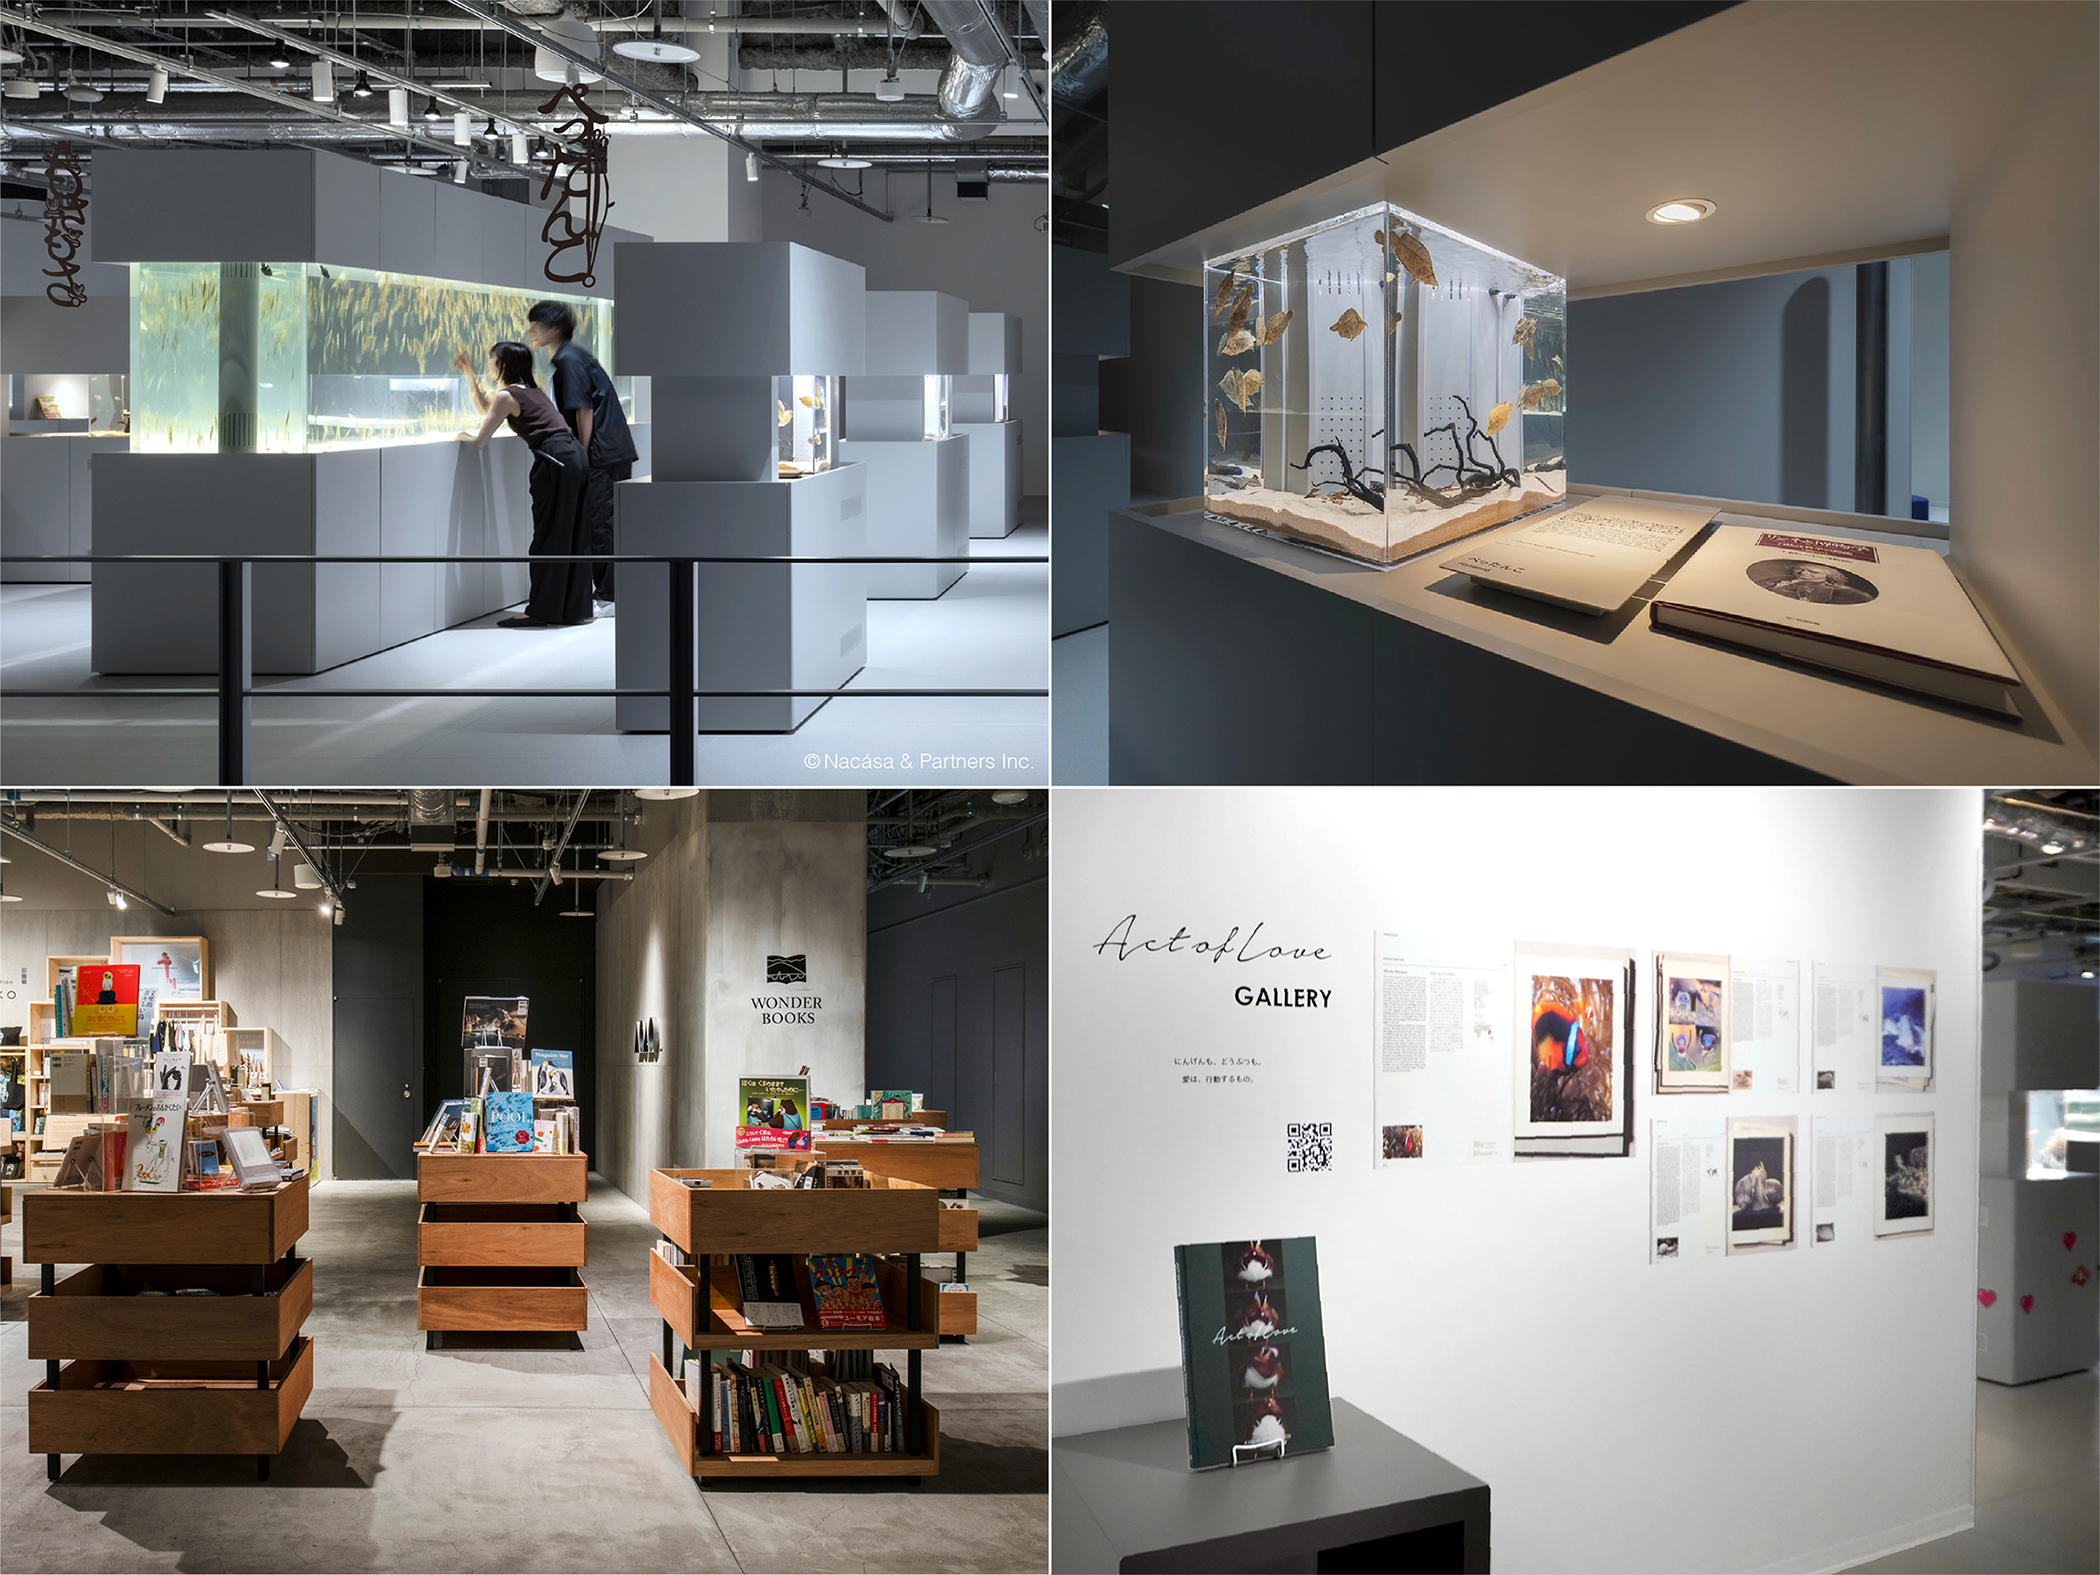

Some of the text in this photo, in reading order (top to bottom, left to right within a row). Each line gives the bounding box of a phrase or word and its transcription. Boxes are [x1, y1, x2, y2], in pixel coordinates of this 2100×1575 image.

[751, 996, 823, 1009] WONDER
[1235, 986, 1332, 1008] GALLERY
[762, 1011, 816, 1025] BOOKS
[491, 1111, 530, 1123] POOL
